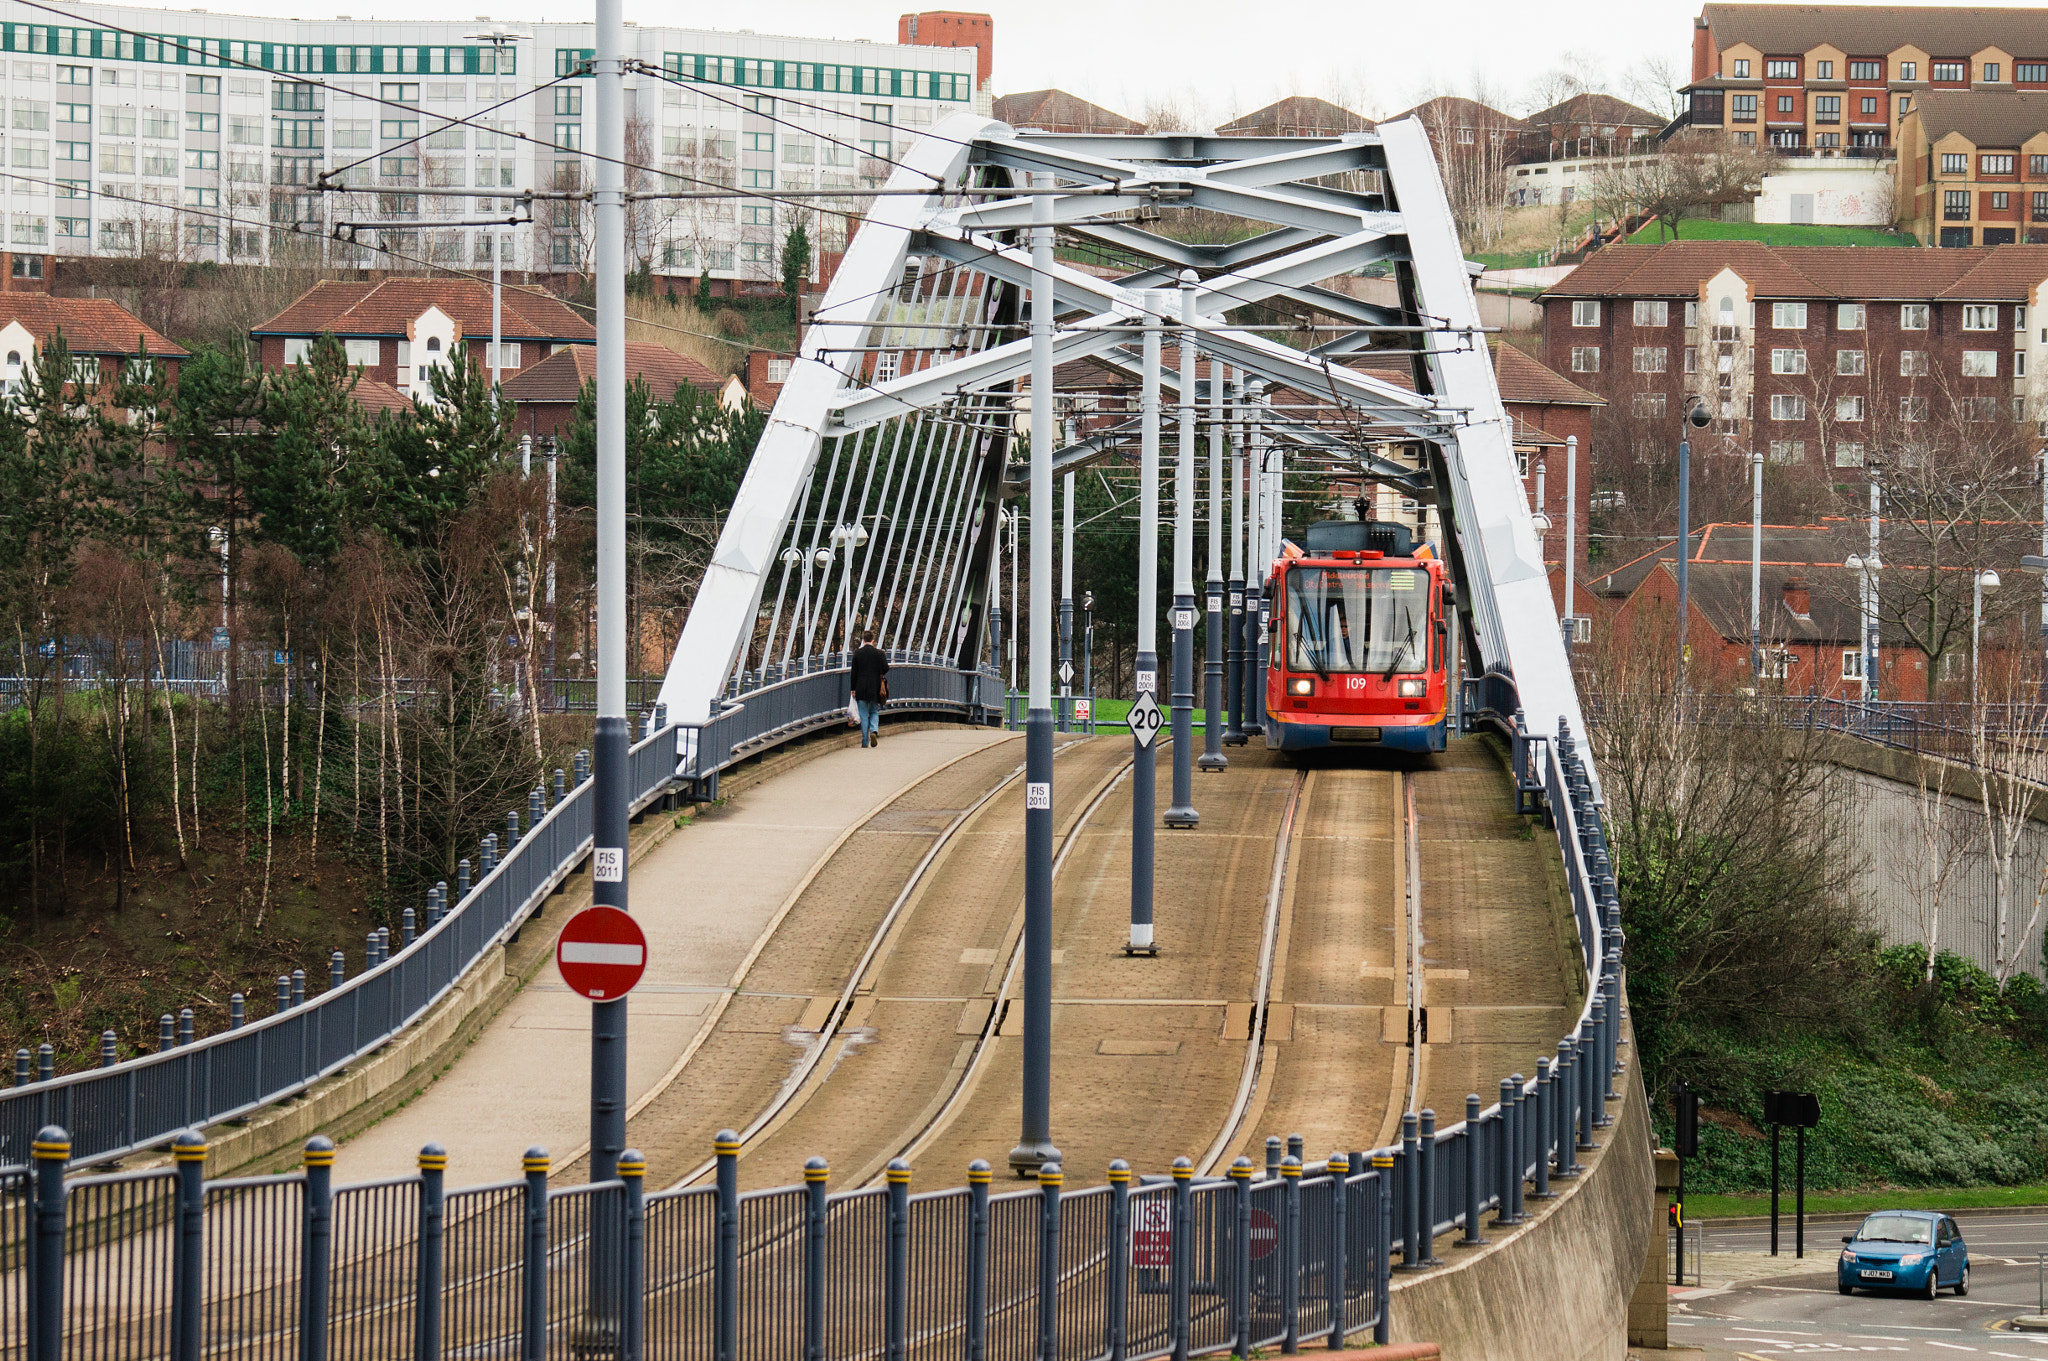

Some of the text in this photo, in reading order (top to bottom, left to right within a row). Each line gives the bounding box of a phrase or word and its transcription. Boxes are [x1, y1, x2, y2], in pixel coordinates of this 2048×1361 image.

[1321, 571, 1370, 580] Middlewood
[1346, 678, 1366, 690] 109
[1134, 708, 1160, 730] 20
[1032, 786, 1044, 796] FIS
[1030, 797, 1047, 806] 2010
[599, 852, 616, 864] FIS
[596, 866, 618, 877] 2011
